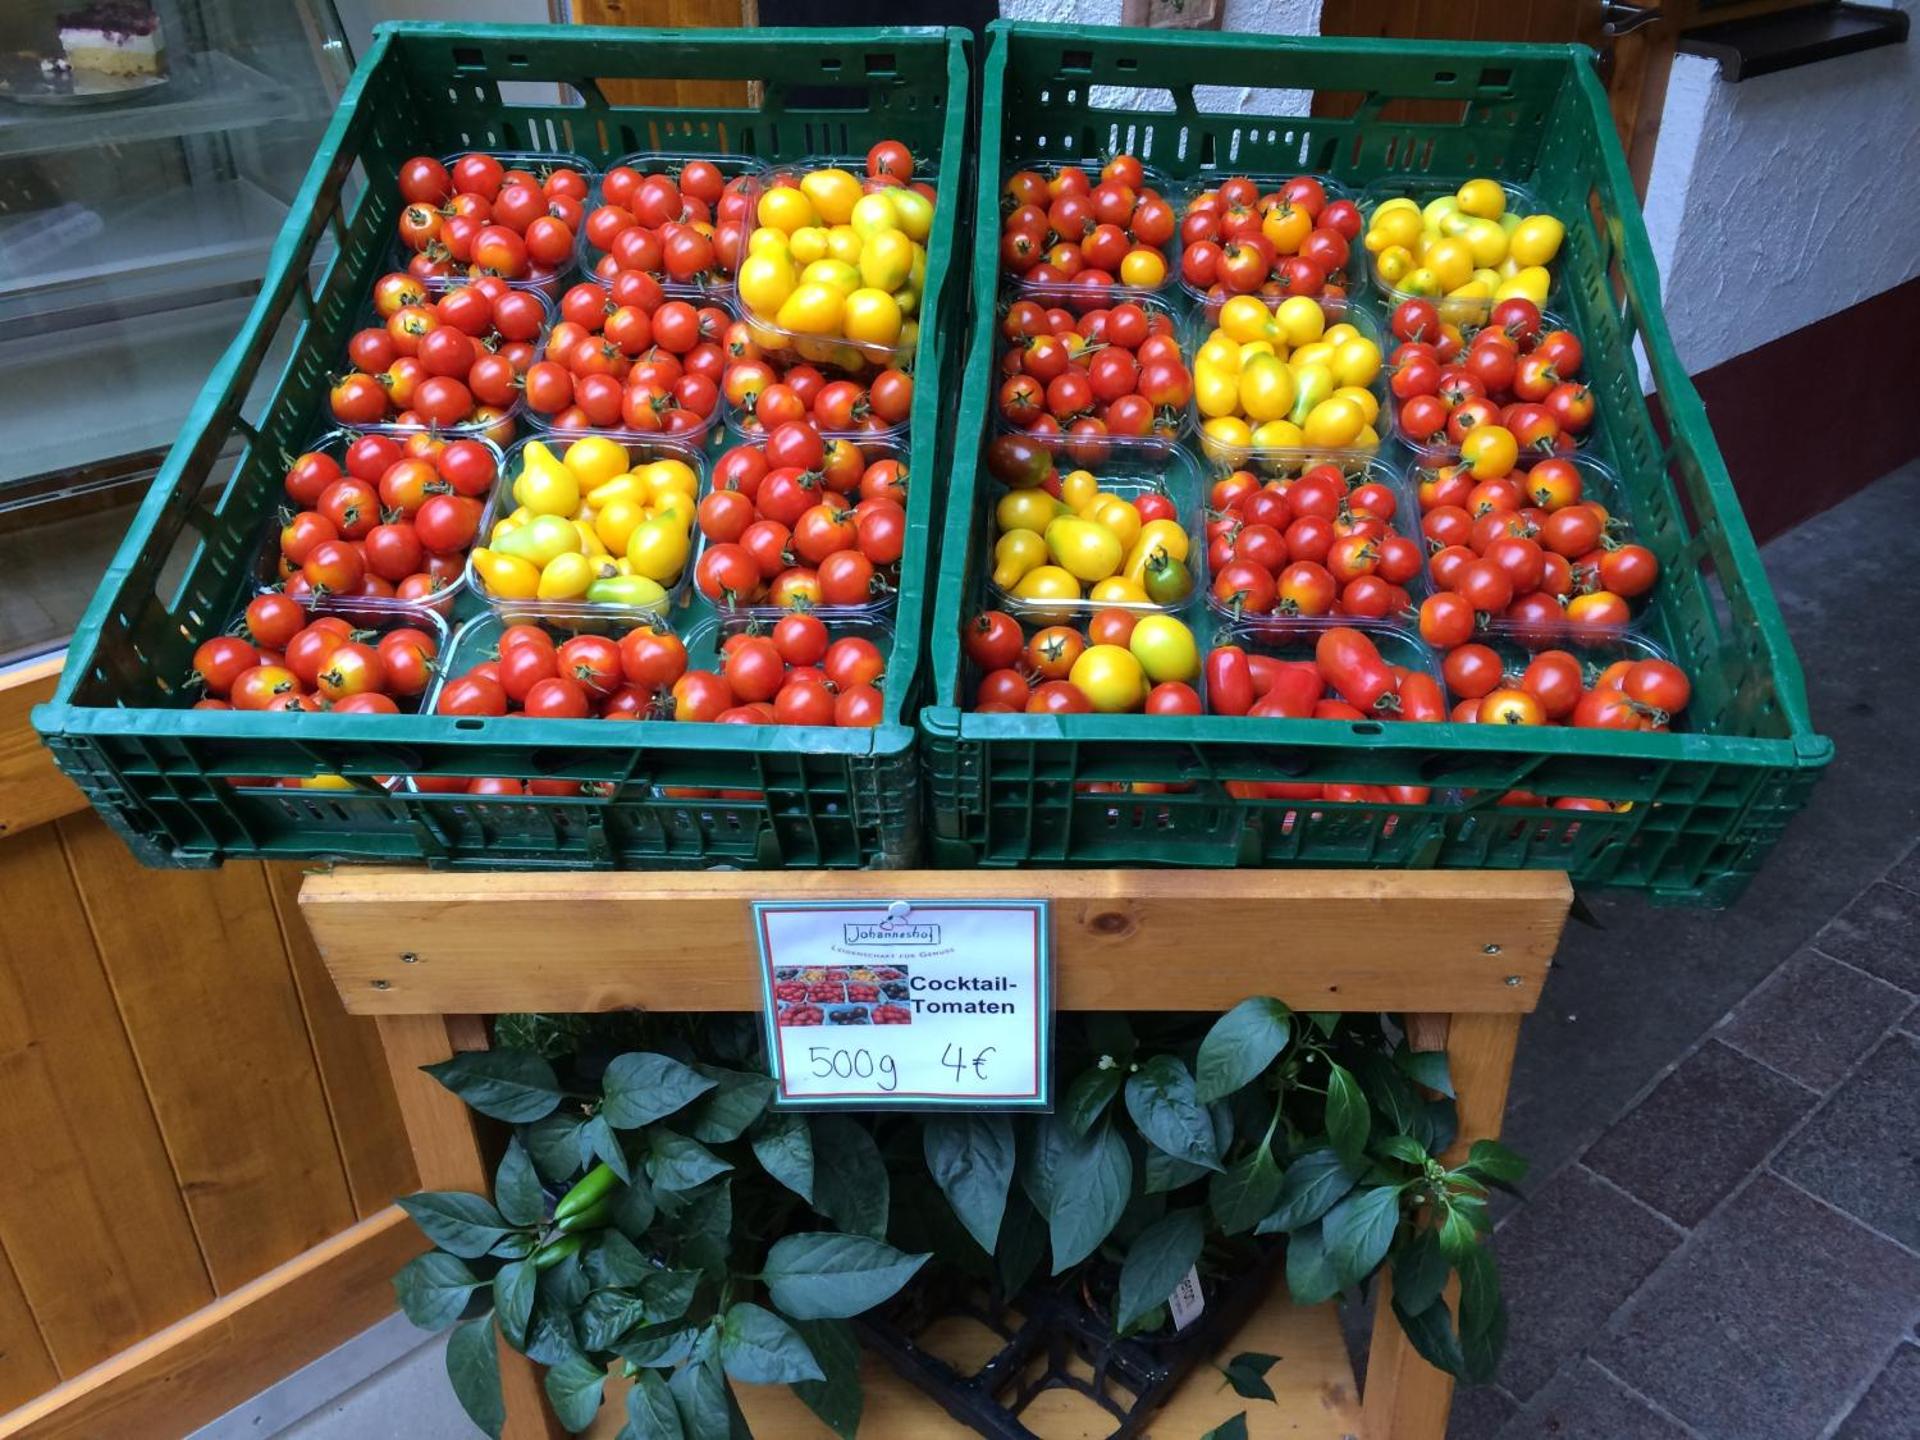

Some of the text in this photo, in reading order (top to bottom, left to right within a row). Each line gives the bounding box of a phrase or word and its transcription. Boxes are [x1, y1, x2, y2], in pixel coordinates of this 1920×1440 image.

[848, 926, 934, 943] Johanneshof
[910, 976, 1017, 991] Cocktail-
[911, 998, 1015, 1014] Tomaten
[809, 1046, 898, 1091] 500g
